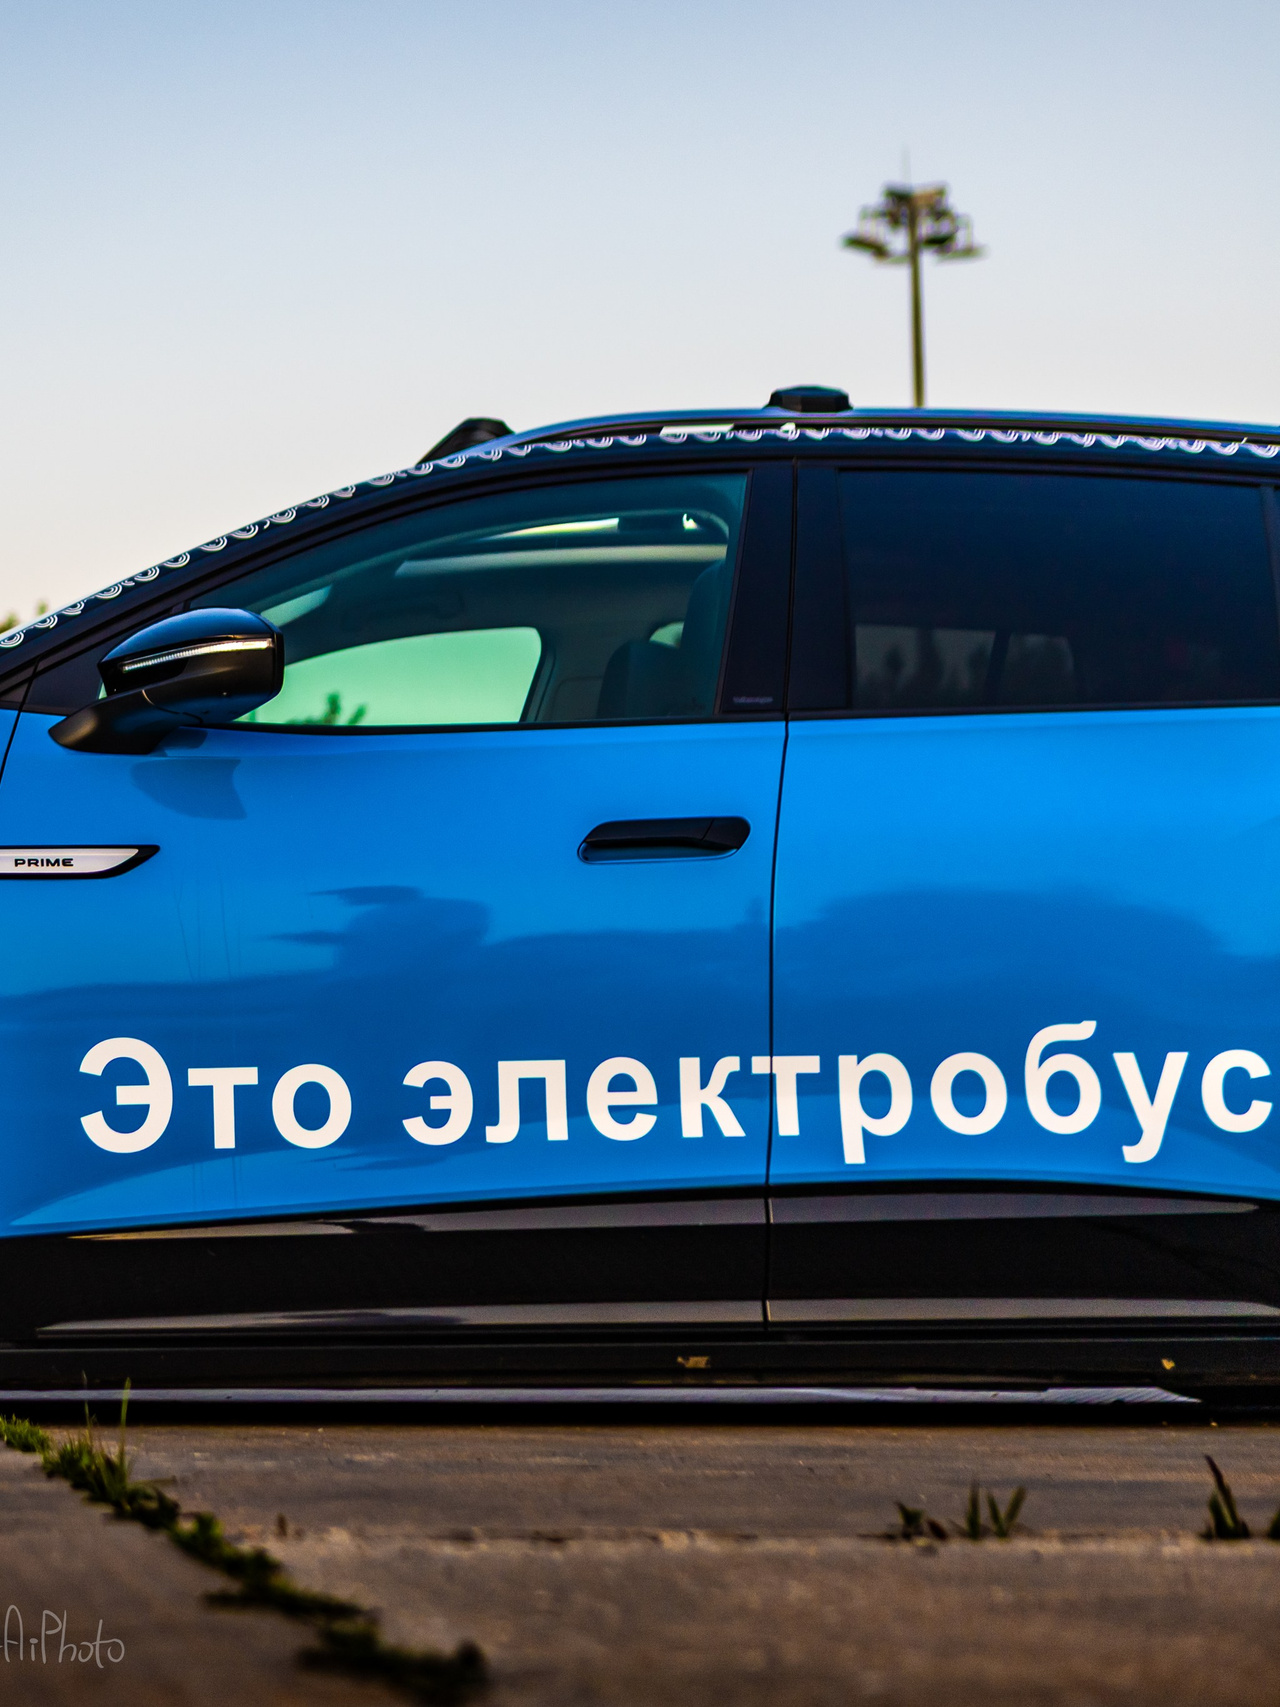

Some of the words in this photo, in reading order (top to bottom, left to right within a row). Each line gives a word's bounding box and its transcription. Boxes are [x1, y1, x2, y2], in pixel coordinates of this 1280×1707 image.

[14, 857, 74, 868] PRIME
[80, 1038, 351, 1153] Это
[403, 1021, 1273, 1164] электробус
